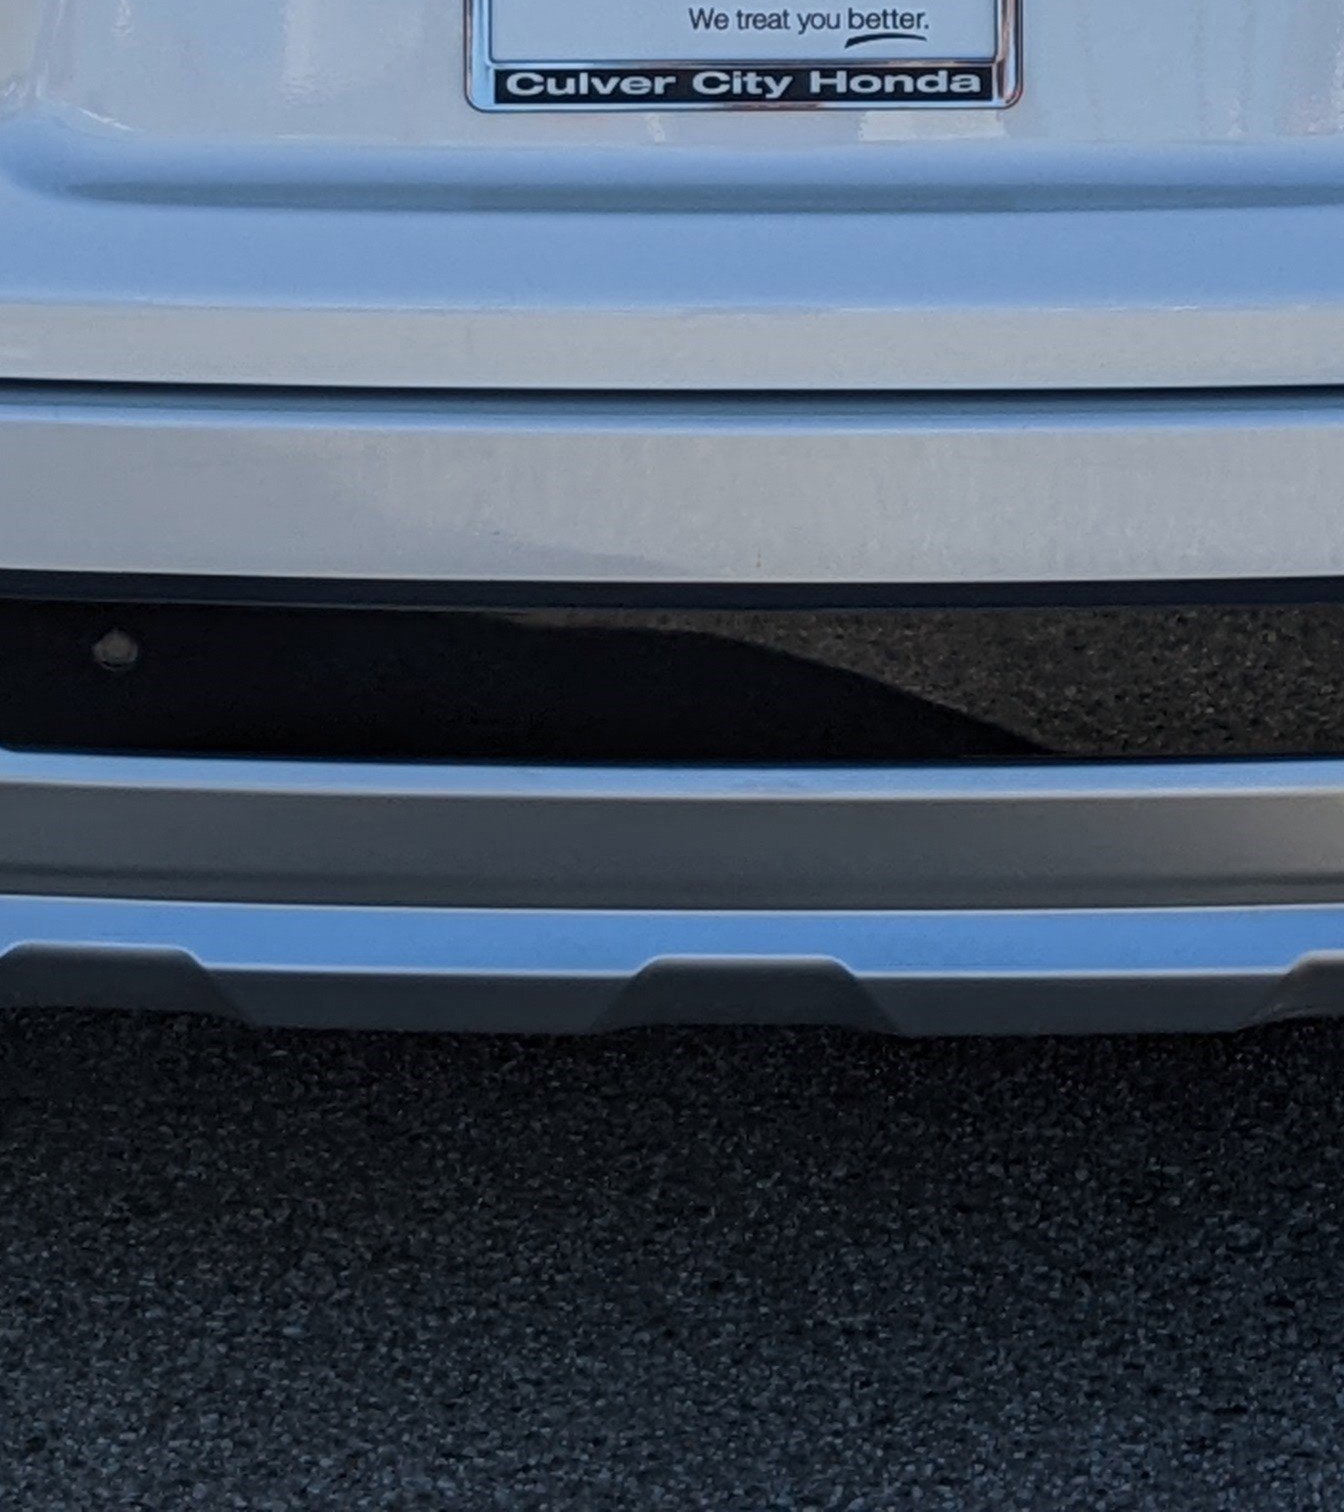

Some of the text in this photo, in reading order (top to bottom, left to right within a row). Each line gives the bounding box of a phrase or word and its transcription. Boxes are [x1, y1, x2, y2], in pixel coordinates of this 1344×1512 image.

[689, 8, 930, 37] We treat you better.
[506, 70, 981, 101] Culver City Honda
